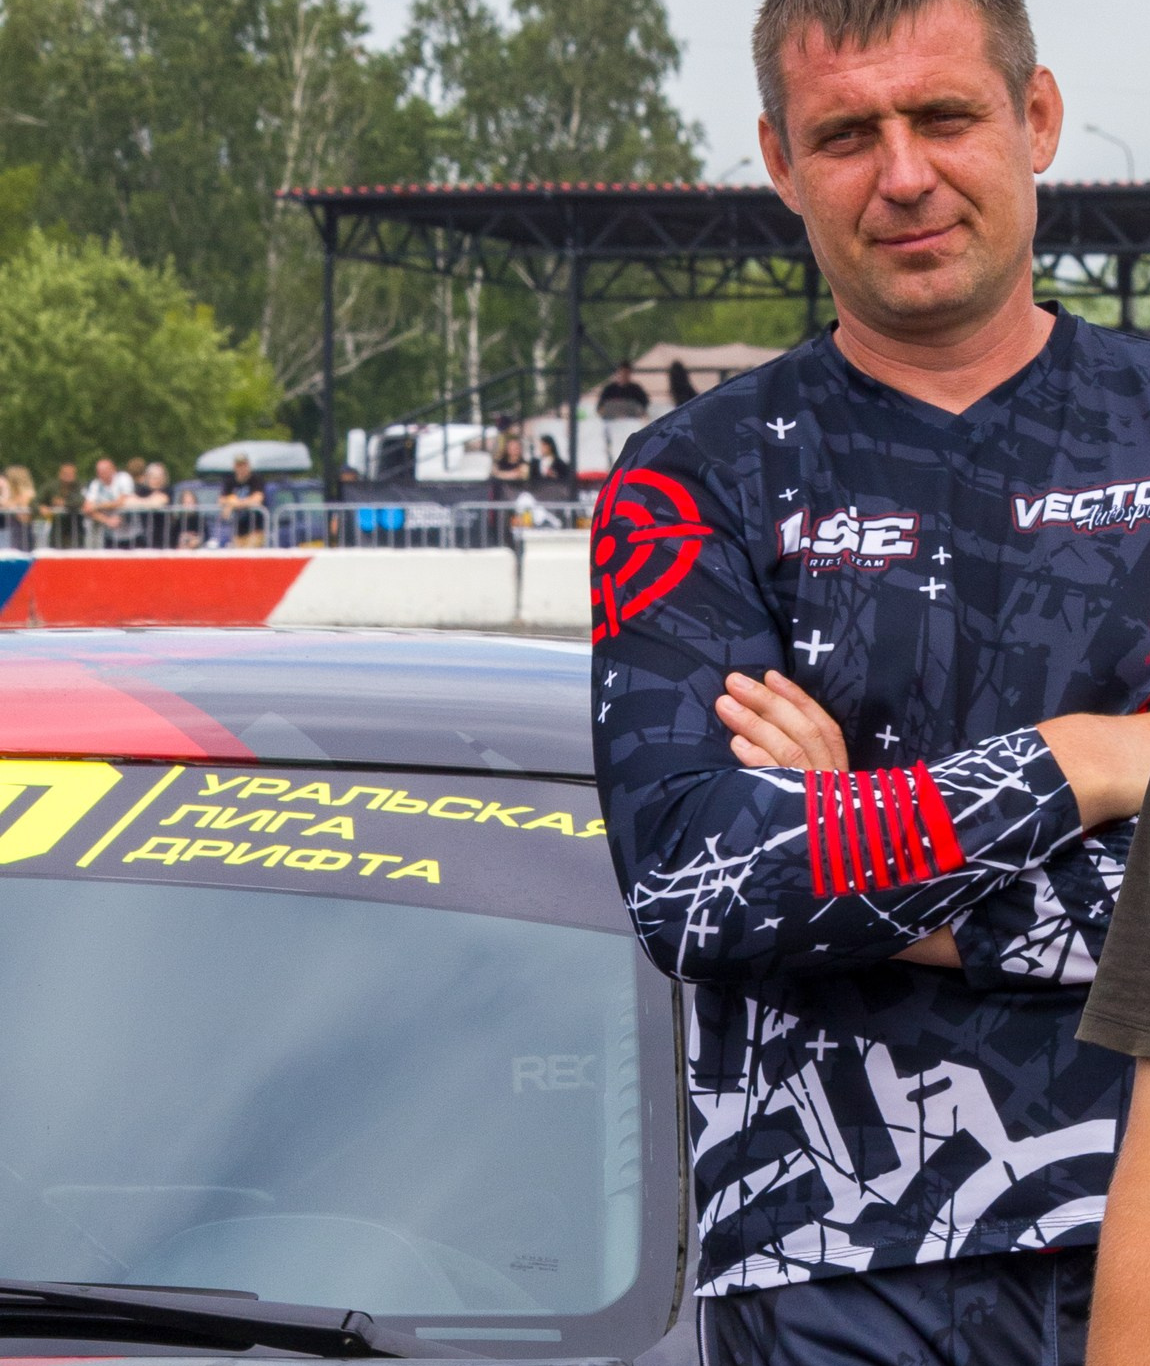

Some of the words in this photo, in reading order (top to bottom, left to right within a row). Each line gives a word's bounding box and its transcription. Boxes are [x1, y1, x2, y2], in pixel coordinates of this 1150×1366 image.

[808, 557, 842, 568] RIFT
[160, 804, 355, 840] ЛИГА
[123, 836, 441, 884] ДРИФТА
